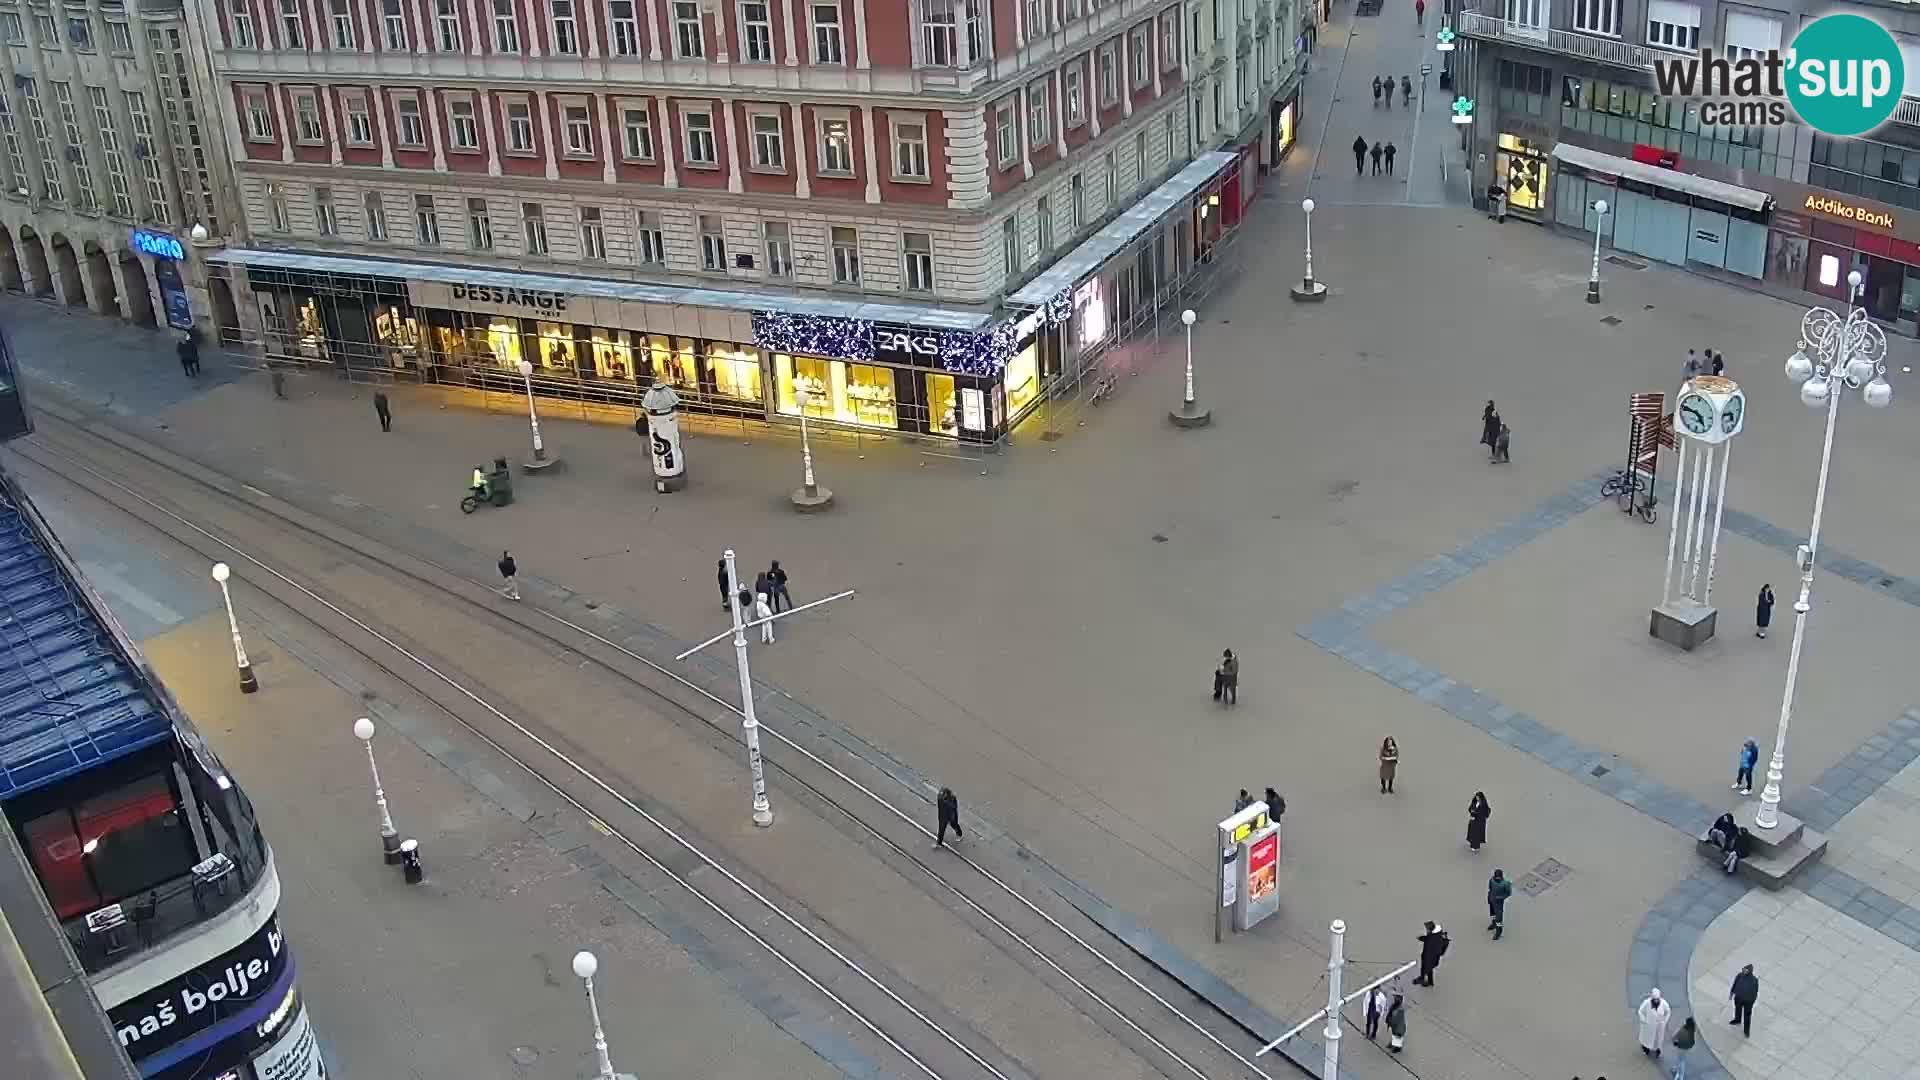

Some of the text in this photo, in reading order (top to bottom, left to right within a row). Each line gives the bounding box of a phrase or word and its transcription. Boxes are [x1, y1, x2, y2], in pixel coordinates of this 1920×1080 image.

[1805, 195, 1893, 228] Addiko Bank
[452, 282, 566, 311] DESSANGE
[877, 331, 938, 355] ZAKS
[117, 999, 177, 1046] naš
[181, 958, 269, 1015] bolje,
